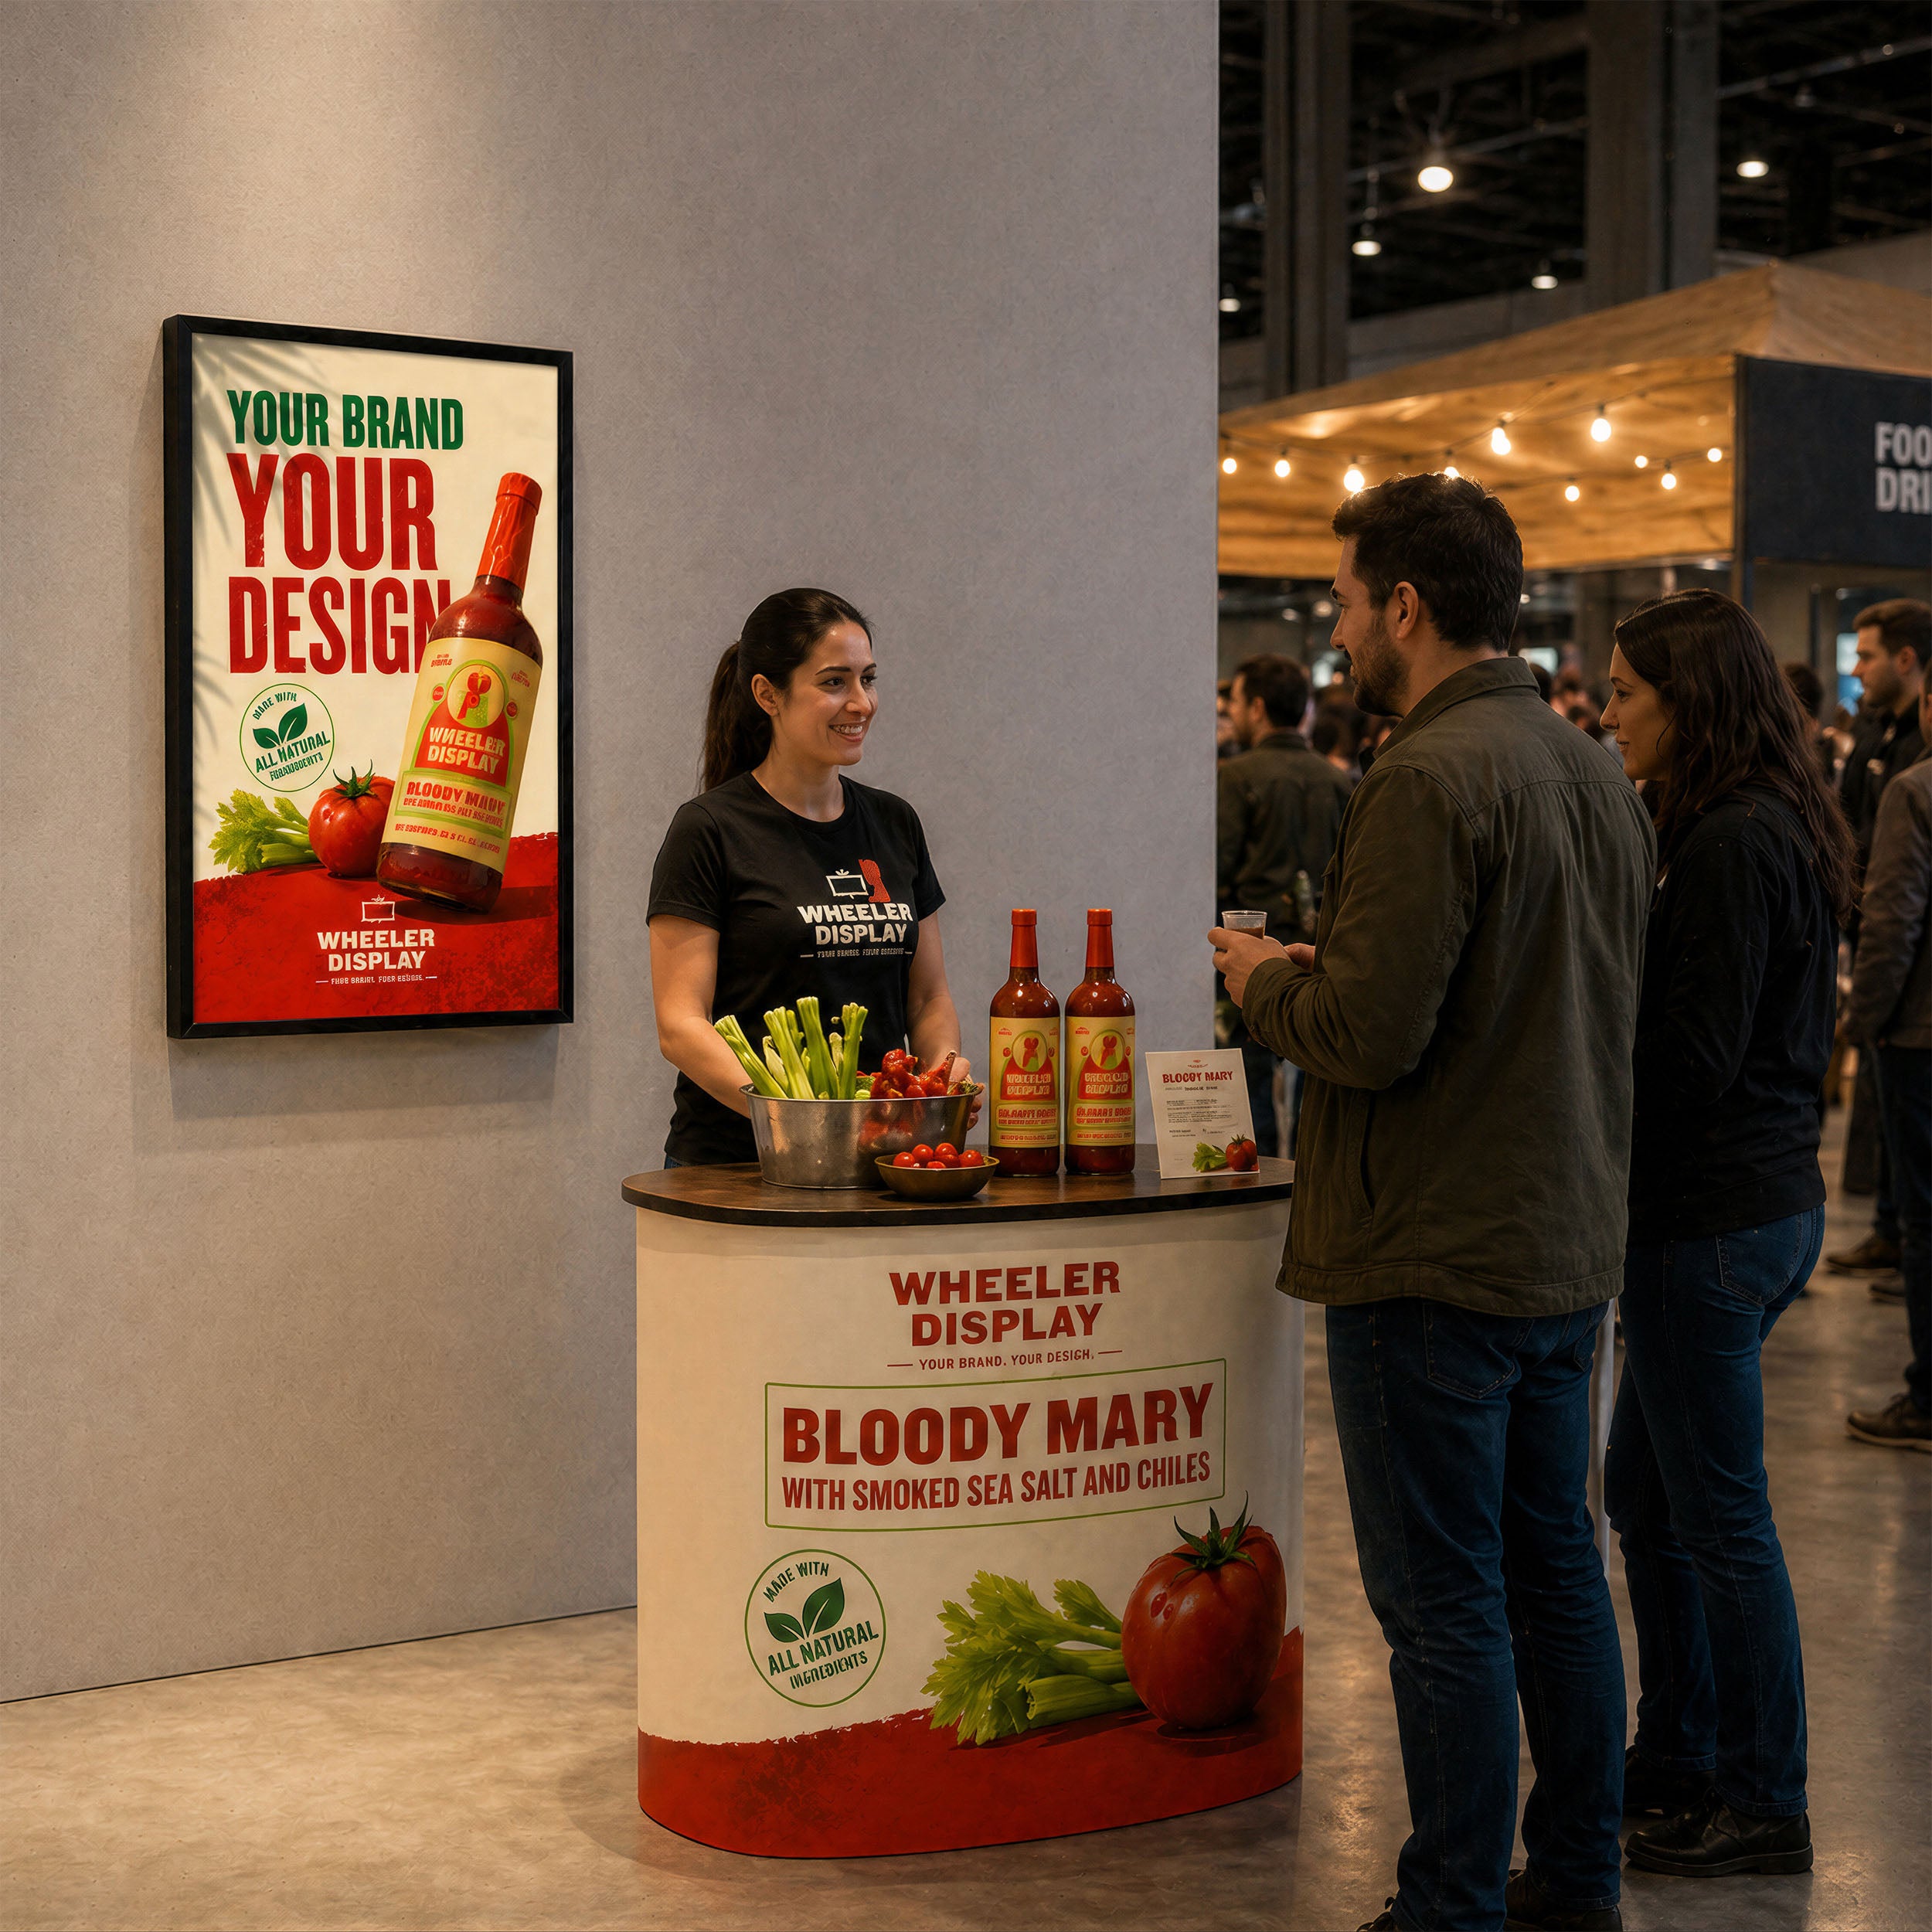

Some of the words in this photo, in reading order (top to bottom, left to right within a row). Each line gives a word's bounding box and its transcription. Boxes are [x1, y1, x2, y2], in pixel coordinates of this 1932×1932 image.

[226, 389, 330, 446] YOUR
[342, 394, 464, 450] BRAND
[1875, 421, 1932, 468] FOO
[226, 453, 438, 570] YOUR
[228, 577, 451, 675] DESIGN
[255, 753, 277, 774] ALL
[277, 730, 331, 763] NATURAL
[427, 745, 500, 774] DISPLAY
[797, 903, 913, 923] WHEELER
[815, 923, 907, 945] DISPLAY
[317, 929, 435, 950] WHEELER
[328, 951, 426, 971] DISPLAY
[889, 1261, 1121, 1305] WHEELER
[912, 1303, 1103, 1346] DISPLAY
[919, 1358, 954, 1370] YOUR
[959, 1355, 1006, 1369] BRAND.
[1011, 1353, 1043, 1366] YOUR
[783, 1403, 1031, 1465] BLOODY
[1047, 1383, 1213, 1454] MARY
[782, 1477, 845, 1509] WITH
[852, 1477, 959, 1510] SMOKED
[968, 1473, 1014, 1505] SEA
[1021, 1468, 1077, 1502] SALT
[1083, 1462, 1130, 1495] AND
[1137, 1451, 1211, 1488] CHILES
[763, 1568, 795, 1603] MADE
[767, 1649, 800, 1676] ALL
[799, 1621, 879, 1664] NATURAL
